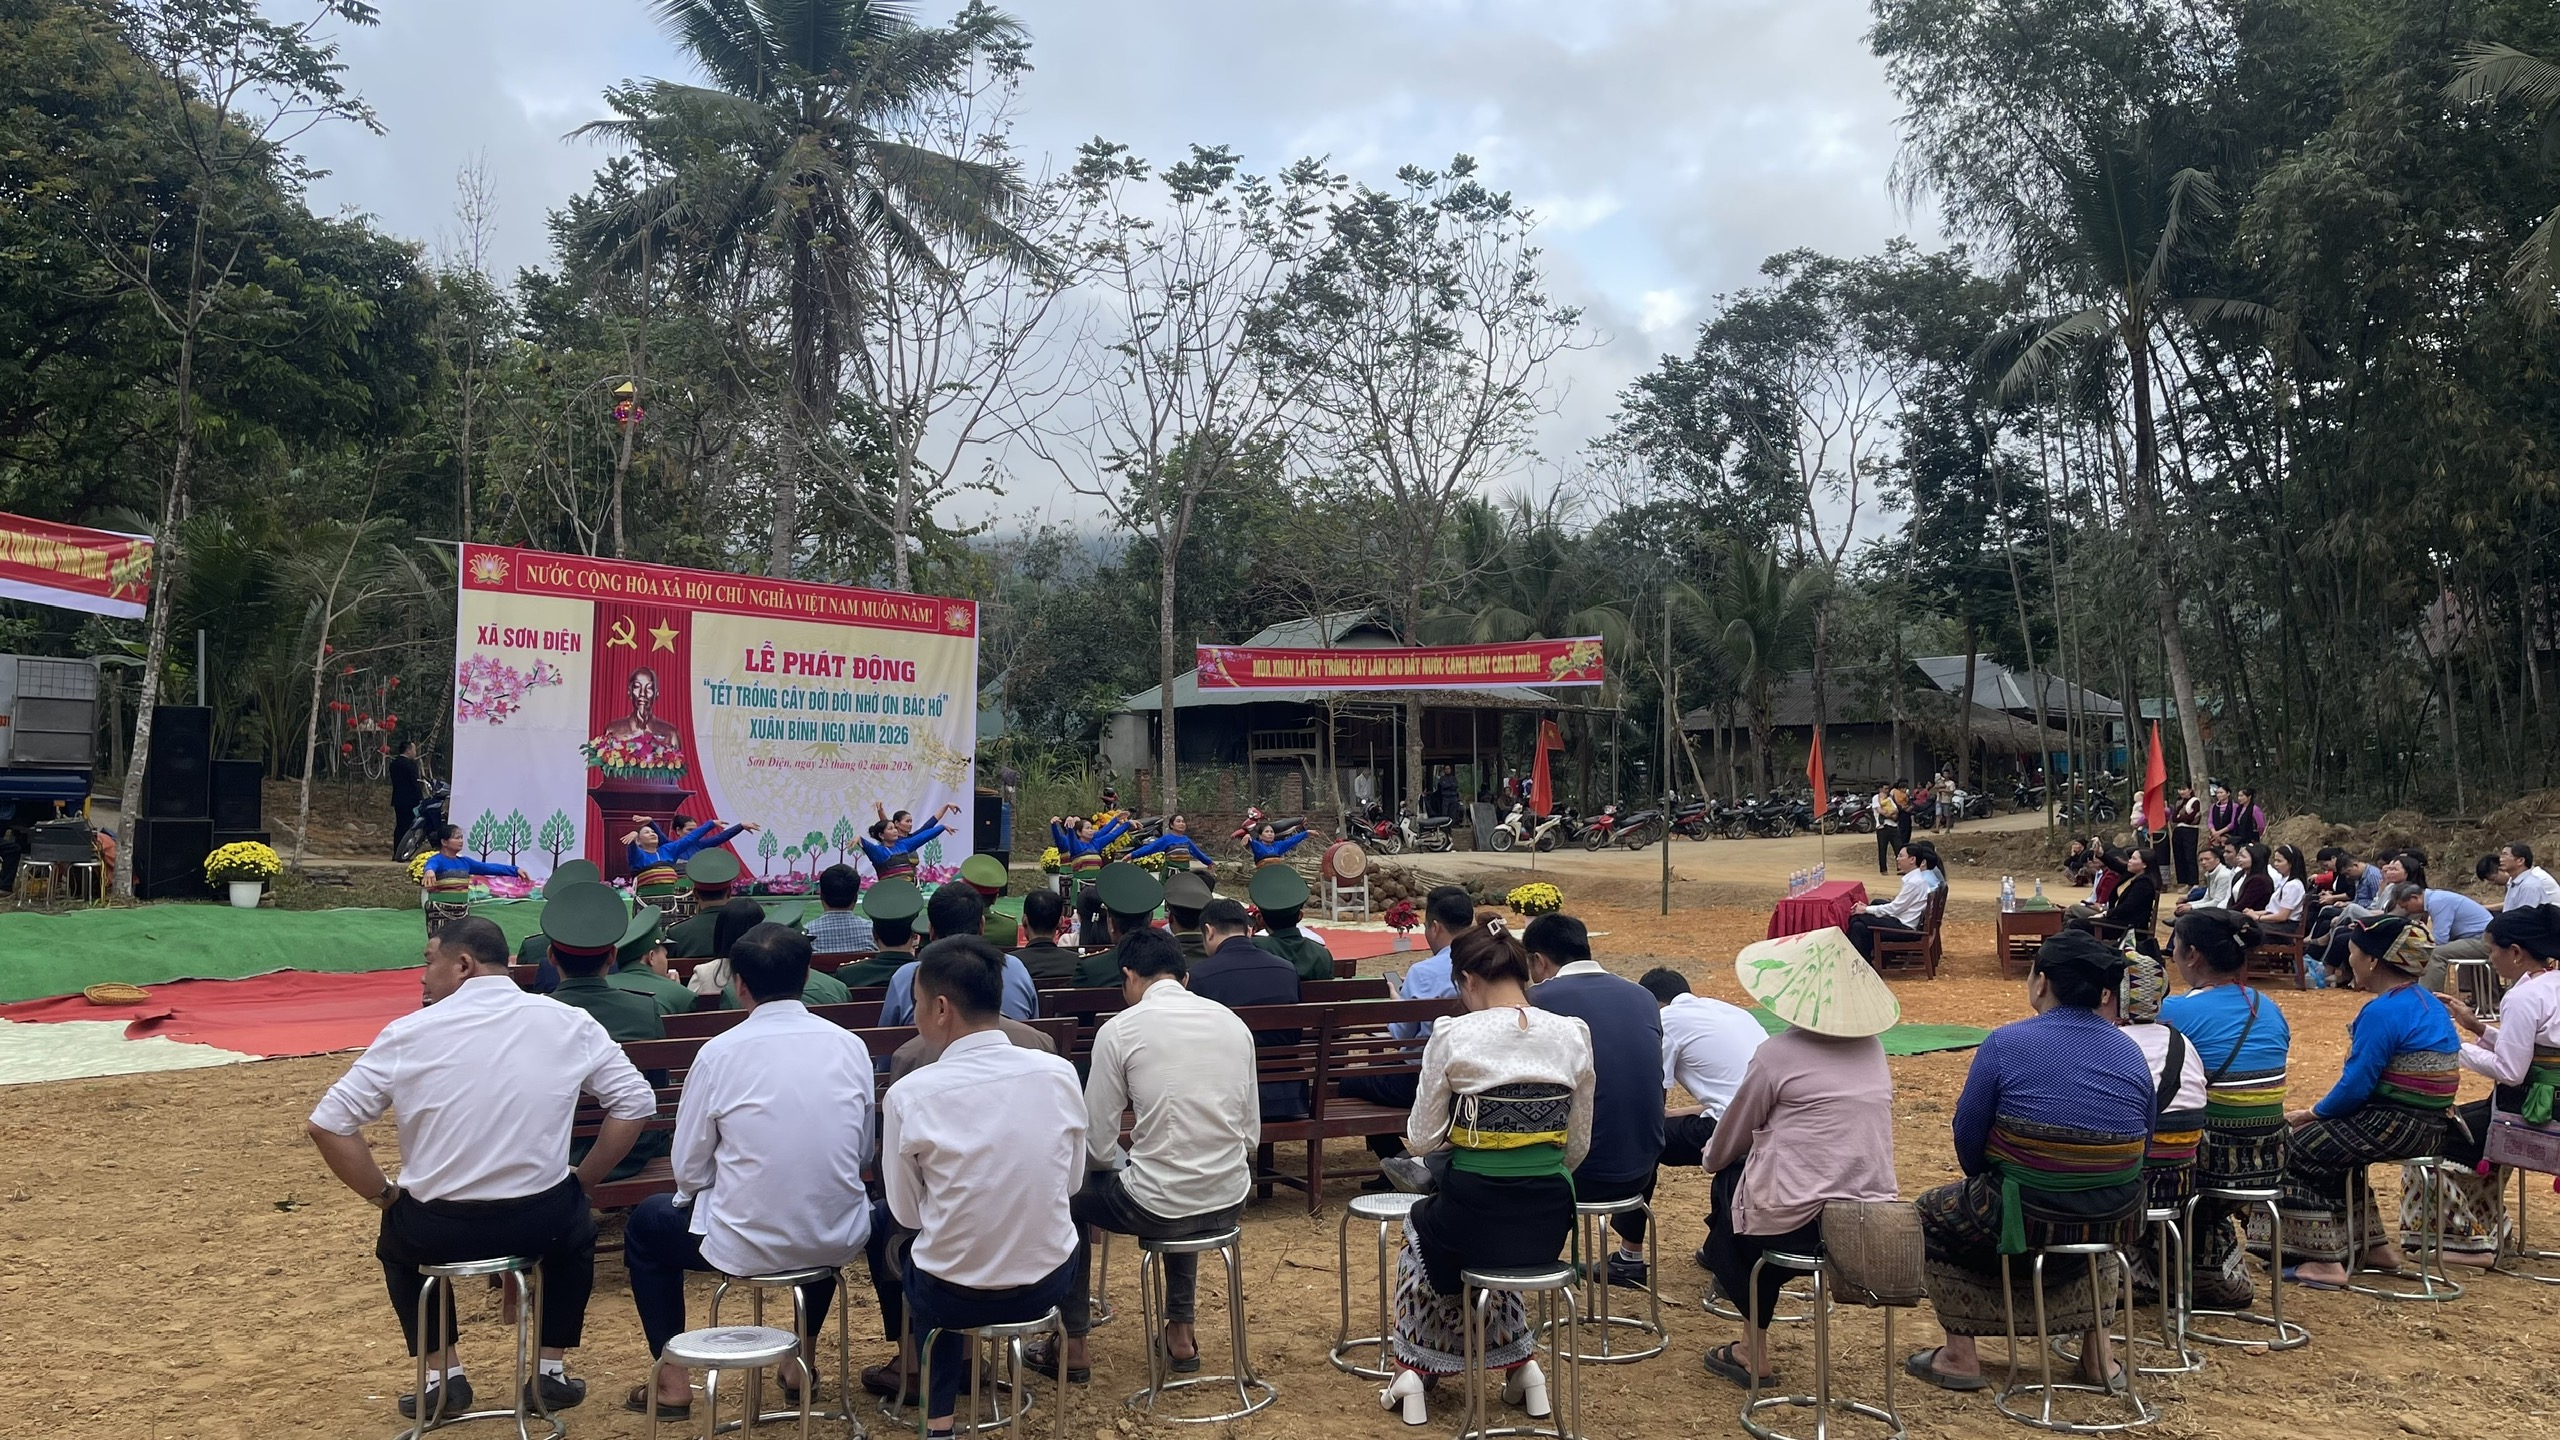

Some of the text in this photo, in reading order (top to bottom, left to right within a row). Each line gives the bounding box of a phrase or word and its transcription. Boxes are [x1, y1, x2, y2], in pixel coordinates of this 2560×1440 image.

[526, 562, 933, 623] NƯỚC CỘNG HÒA XÃ HỘI CHỦ NGHĨA VIỆT NAM MUÔN NĂM!
[477, 622, 581, 655] XÃ SƠN ĐIỆN
[745, 640, 915, 685] LỄ PHÁT ĐỘNG
[1253, 656, 1271, 677] MÙA
[1272, 656, 1294, 677] XUÂN
[1295, 656, 1306, 677] LÀ
[1307, 652, 1322, 677] TẾT
[1323, 652, 1350, 676] TRỒNG
[1352, 654, 1367, 676] CÂY
[1368, 654, 1386, 676] LÀM
[1387, 658, 1403, 676] CHO
[1445, 653, 1467, 674] CÀNG
[1468, 652, 1490, 674] NGÀY
[1492, 652, 1514, 674] CÀNG
[736, 680, 777, 709] TRỒNG
[781, 685, 805, 710] CÂY
[809, 686, 829, 711] ĐỜI
[832, 688, 852, 713] ĐỜI
[856, 691, 879, 714] NHỚ
[883, 694, 899, 715] ƠN
[903, 693, 925, 716] BÁC
[749, 715, 909, 746] XUÂN BÍNH NGỌ NĂM 2026
[891, 760, 913, 771] 2026
